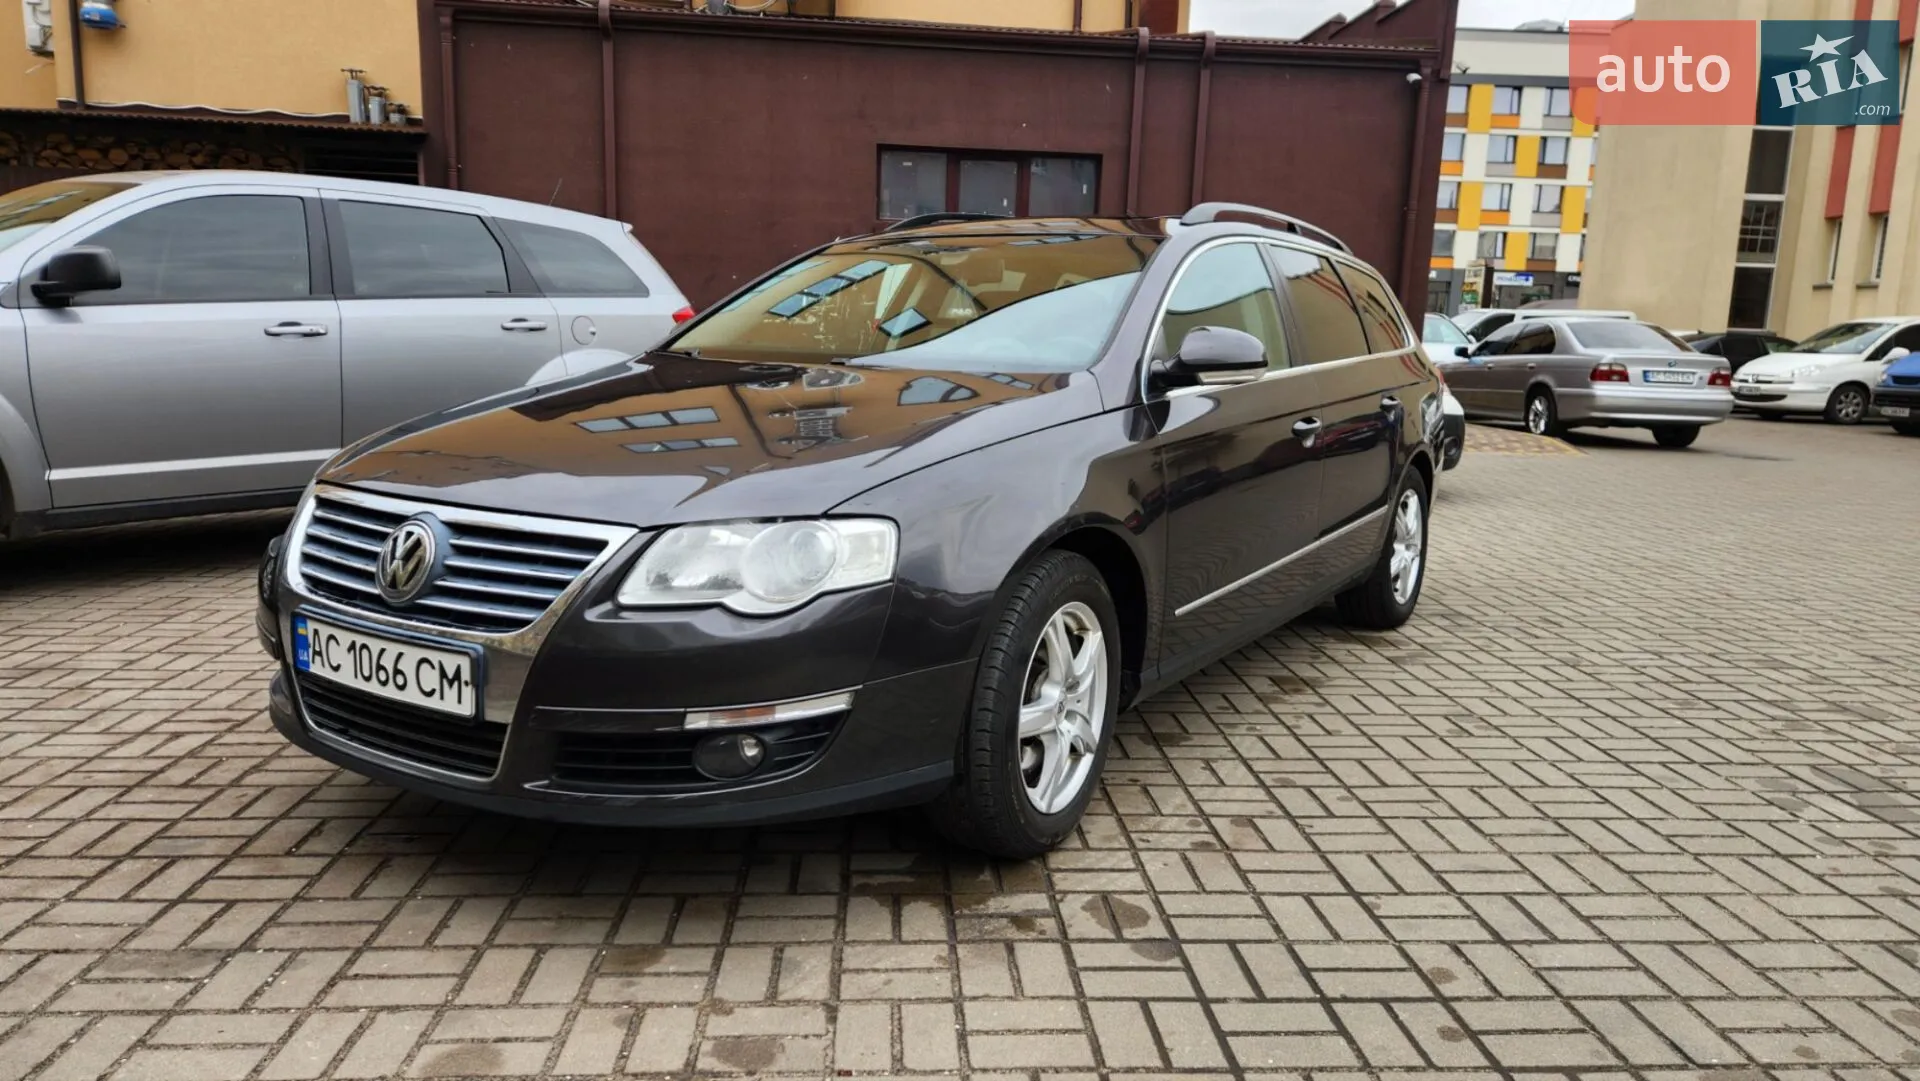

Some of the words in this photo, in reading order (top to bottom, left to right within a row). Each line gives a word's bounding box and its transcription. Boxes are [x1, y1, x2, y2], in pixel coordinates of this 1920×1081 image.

[311, 628, 342, 673] AC
[347, 640, 408, 692] 1066
[415, 657, 463, 705] CM
